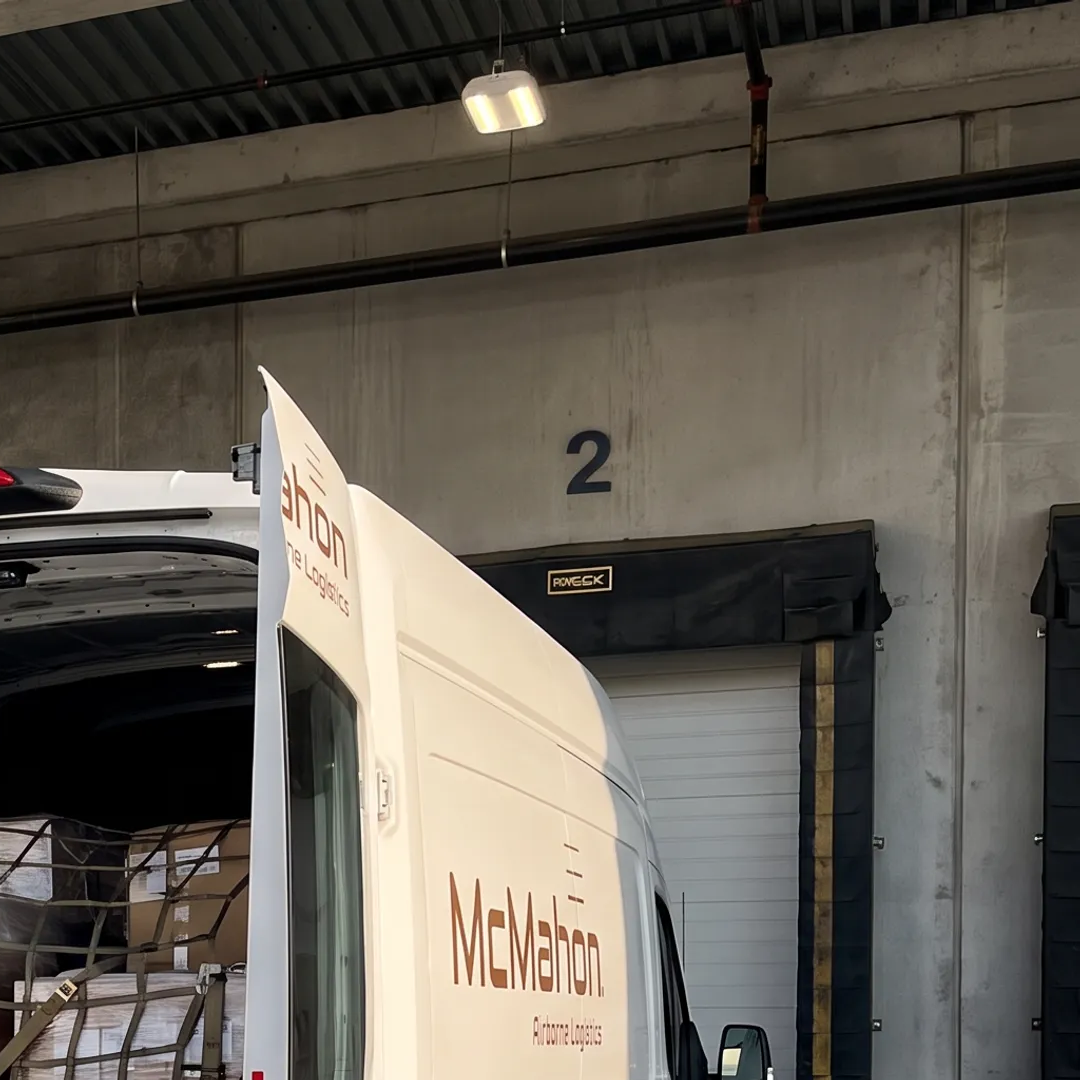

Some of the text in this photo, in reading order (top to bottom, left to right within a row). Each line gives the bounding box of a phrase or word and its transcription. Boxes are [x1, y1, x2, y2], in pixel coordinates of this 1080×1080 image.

[567, 430, 612, 495] 2
[533, 1015, 602, 1052] Airborne Logistics
